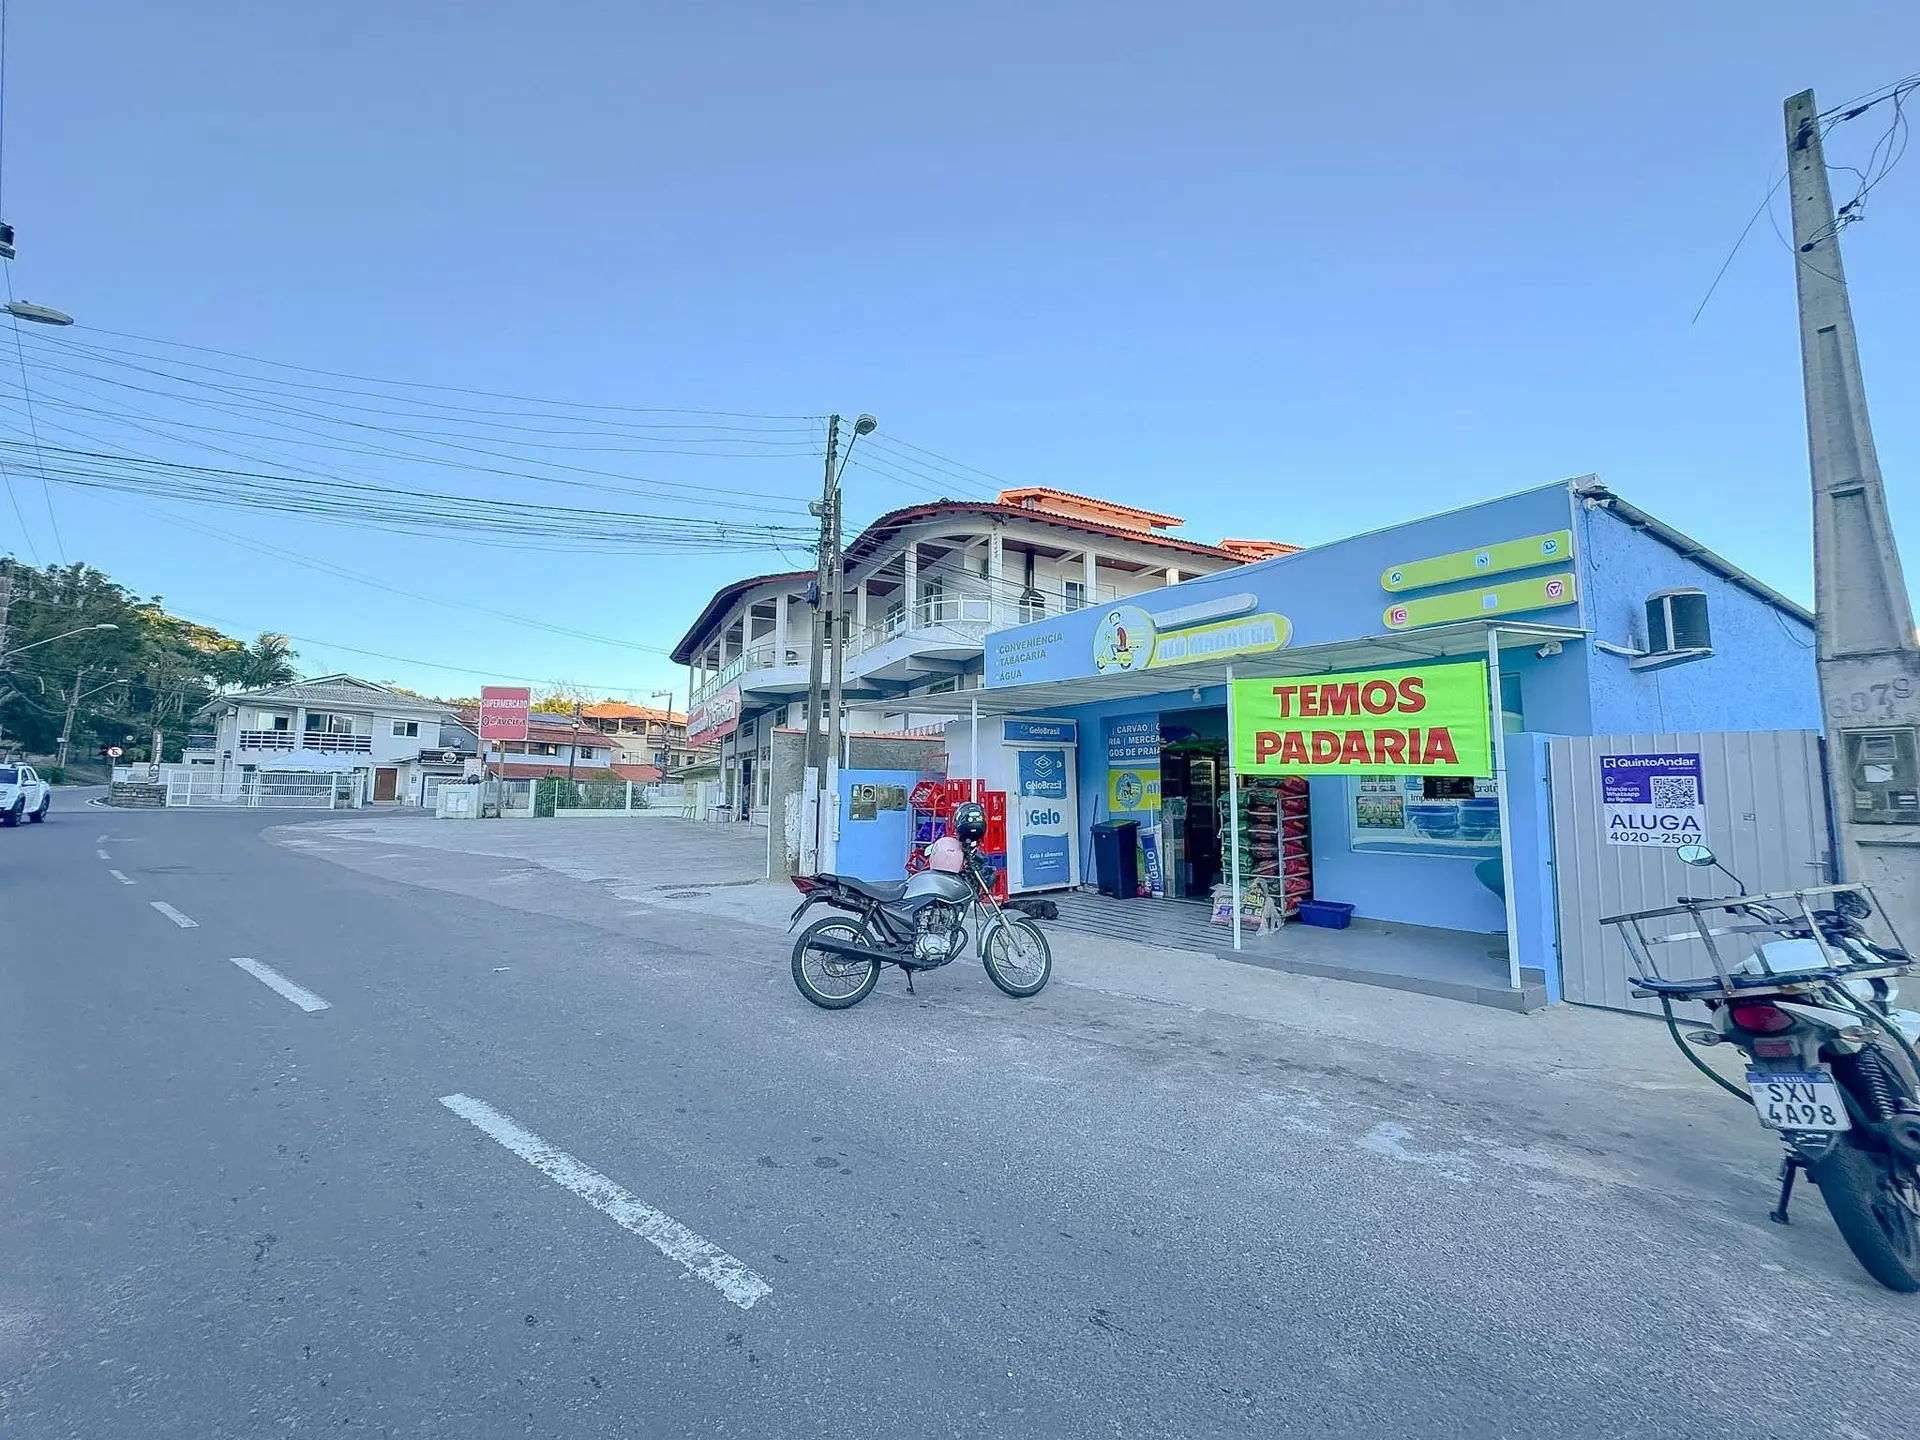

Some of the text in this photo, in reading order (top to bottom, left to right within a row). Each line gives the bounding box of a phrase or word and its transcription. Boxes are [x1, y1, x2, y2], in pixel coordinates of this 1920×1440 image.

[1000, 649, 1046, 667] TABACARIA
[482, 698, 528, 709] SUPERMERCADO
[1272, 677, 1426, 718] TEMOS
[1125, 748, 1137, 756] DE
[1255, 727, 1459, 765] PADARIA
[1617, 757, 1696, 768] QuintoAndar
[1025, 780, 1062, 790] GeloBrasil
[1030, 808, 1060, 825] Gelo
[1610, 814, 1700, 831] ALUGA
[1610, 832, 1702, 844] 4020-2507
[1146, 851, 1159, 879] GELO
[1767, 1083, 1817, 1103] SXV
[1768, 1104, 1837, 1125] 4A98
